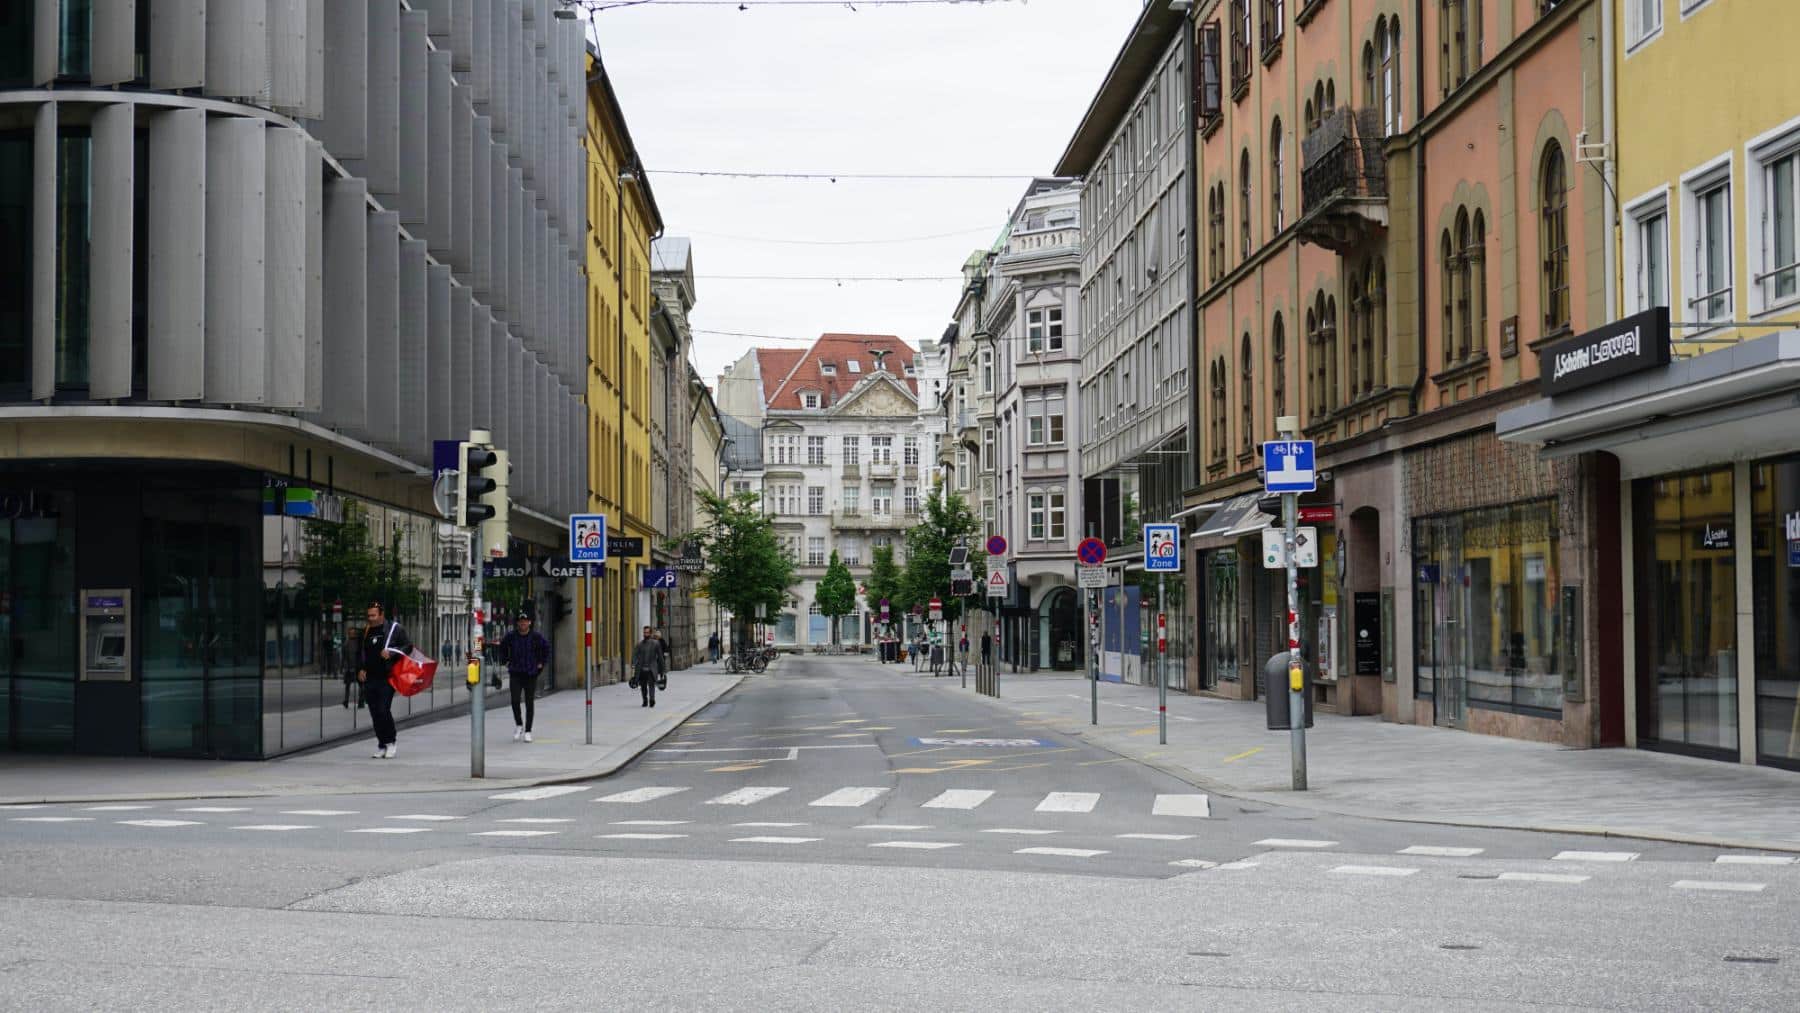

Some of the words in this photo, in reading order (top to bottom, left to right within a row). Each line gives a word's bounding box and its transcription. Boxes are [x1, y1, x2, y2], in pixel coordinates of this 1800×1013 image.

[590, 537, 599, 546] 20
[577, 550, 599, 558] Zone
[1163, 547, 1173, 556] 20
[1151, 559, 1173, 568] Zone
[551, 565, 584, 577] CAFÉ
[665, 574, 675, 587] P
